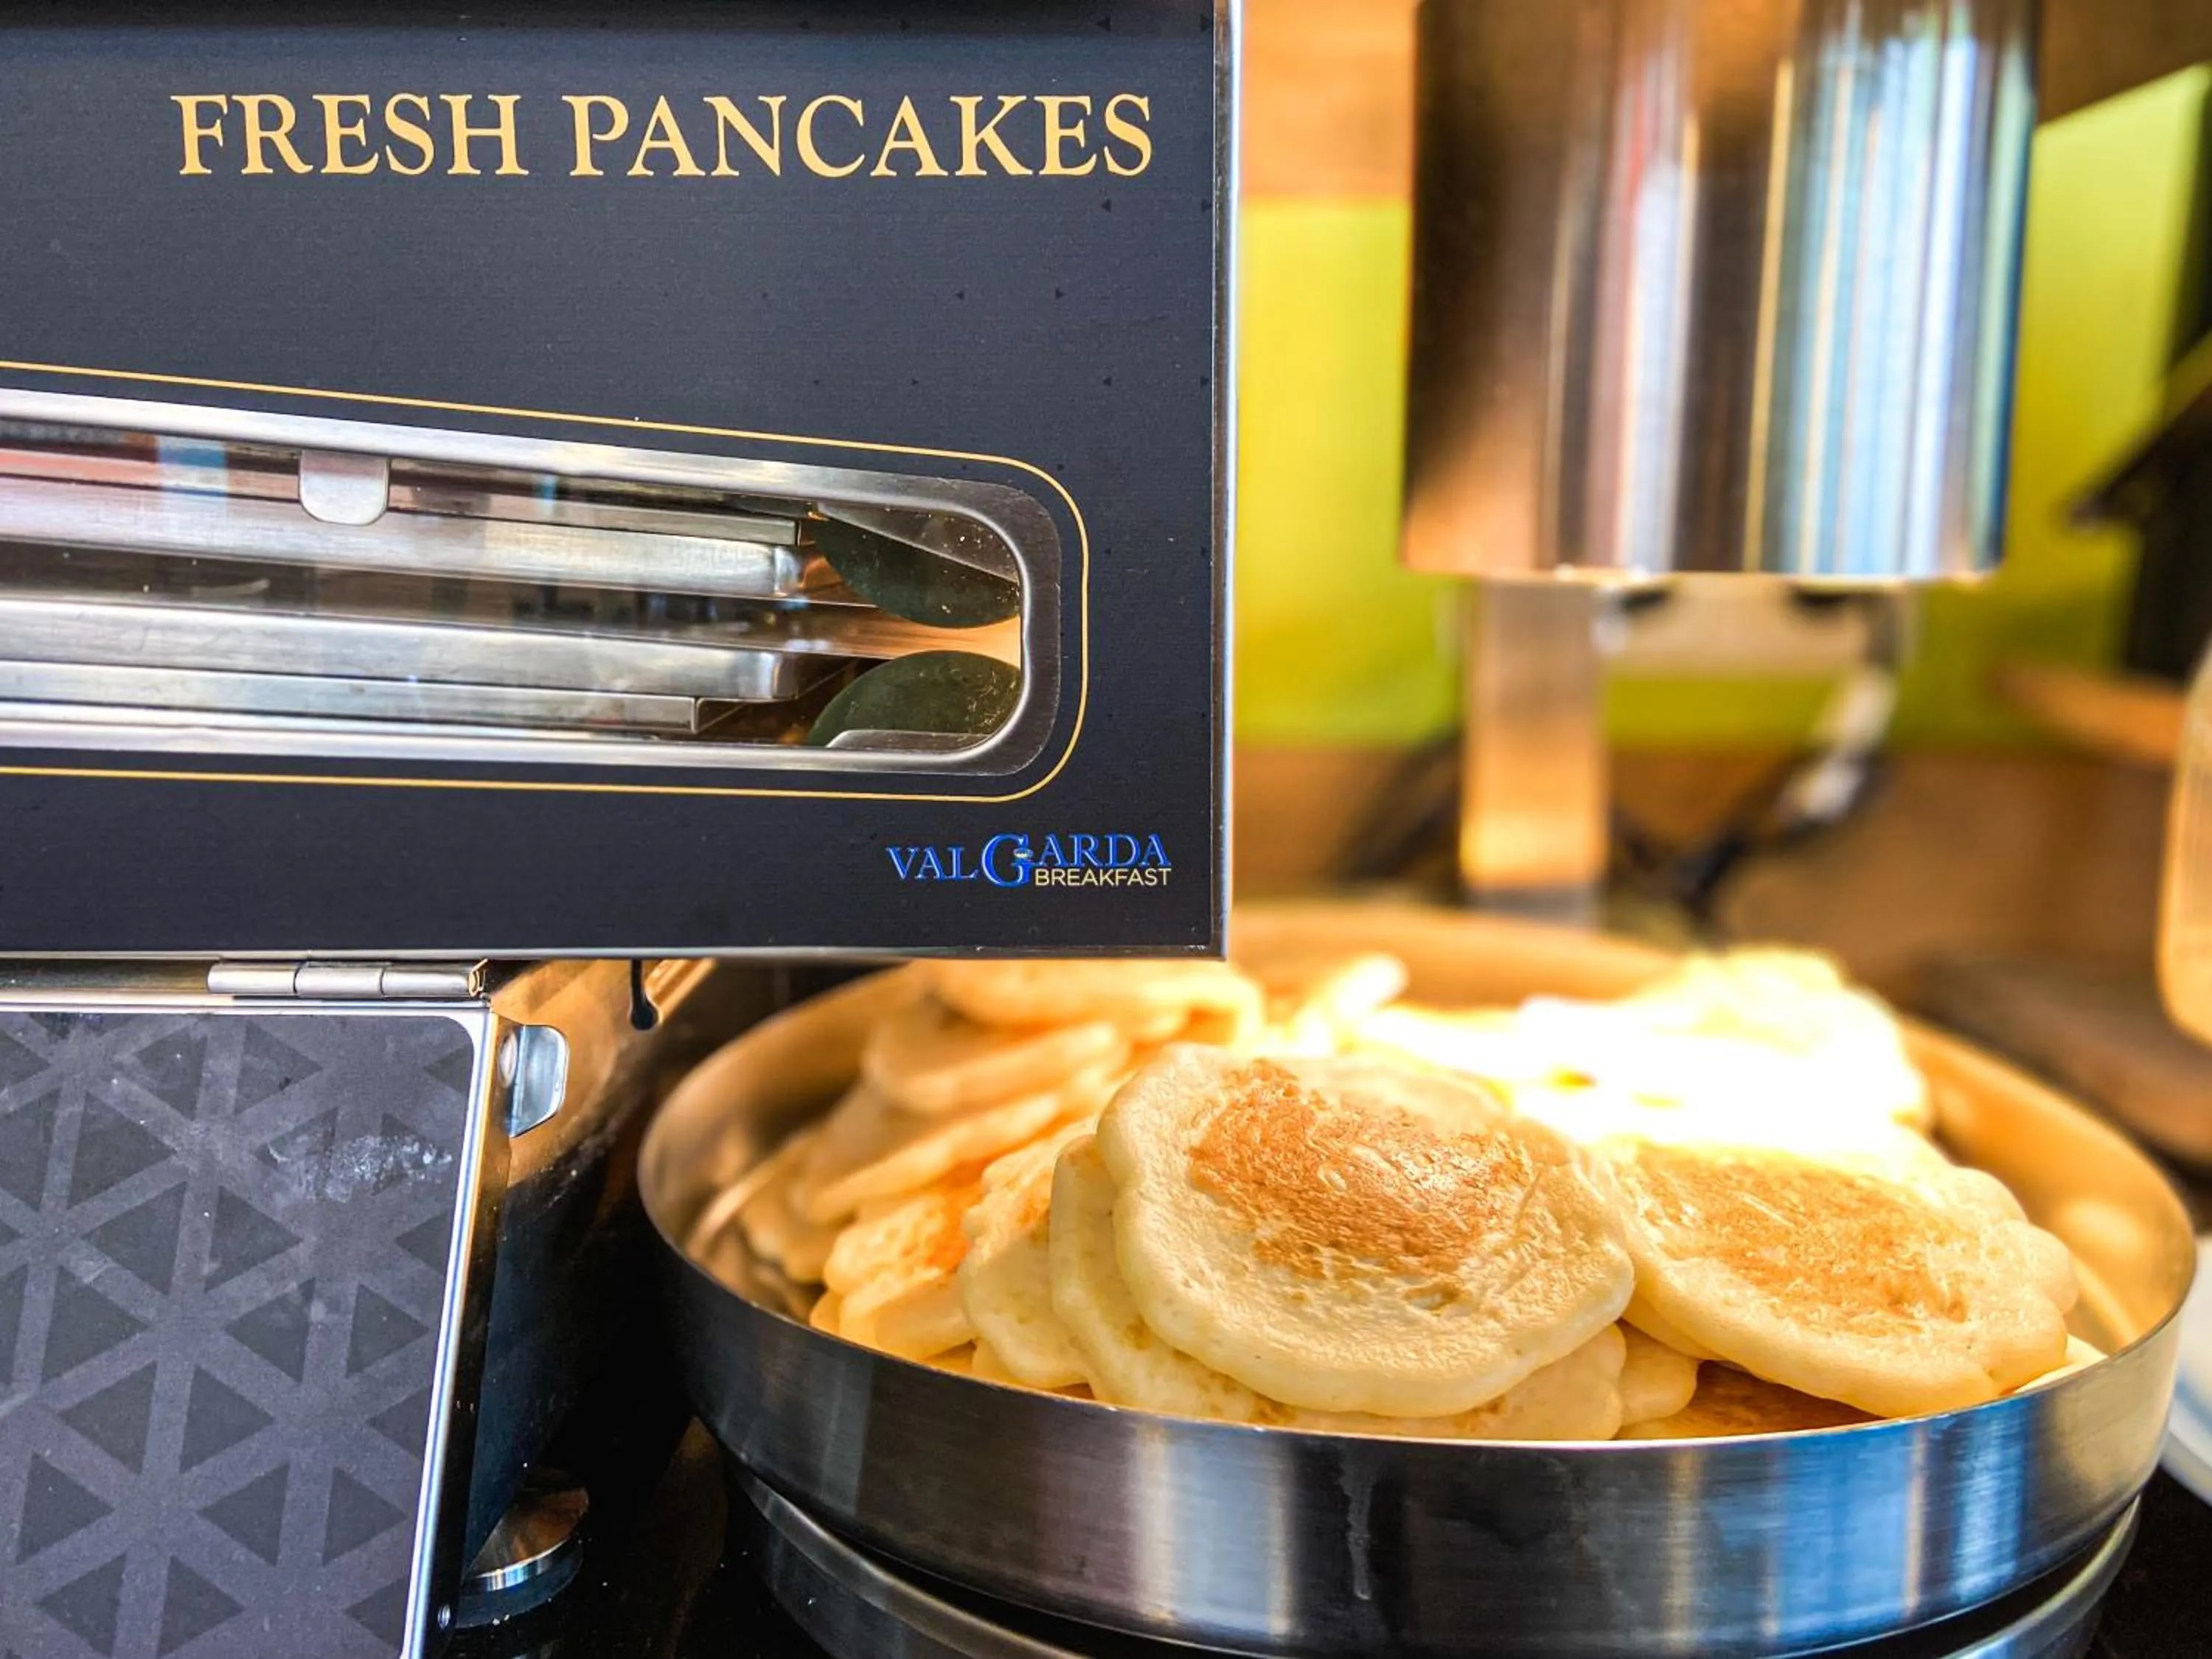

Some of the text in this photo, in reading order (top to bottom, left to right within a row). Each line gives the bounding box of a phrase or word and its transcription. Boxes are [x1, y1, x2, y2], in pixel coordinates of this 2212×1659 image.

[171, 93, 1153, 178] FRESH PANCAKES
[1034, 867, 1172, 886] BREAKFAST
